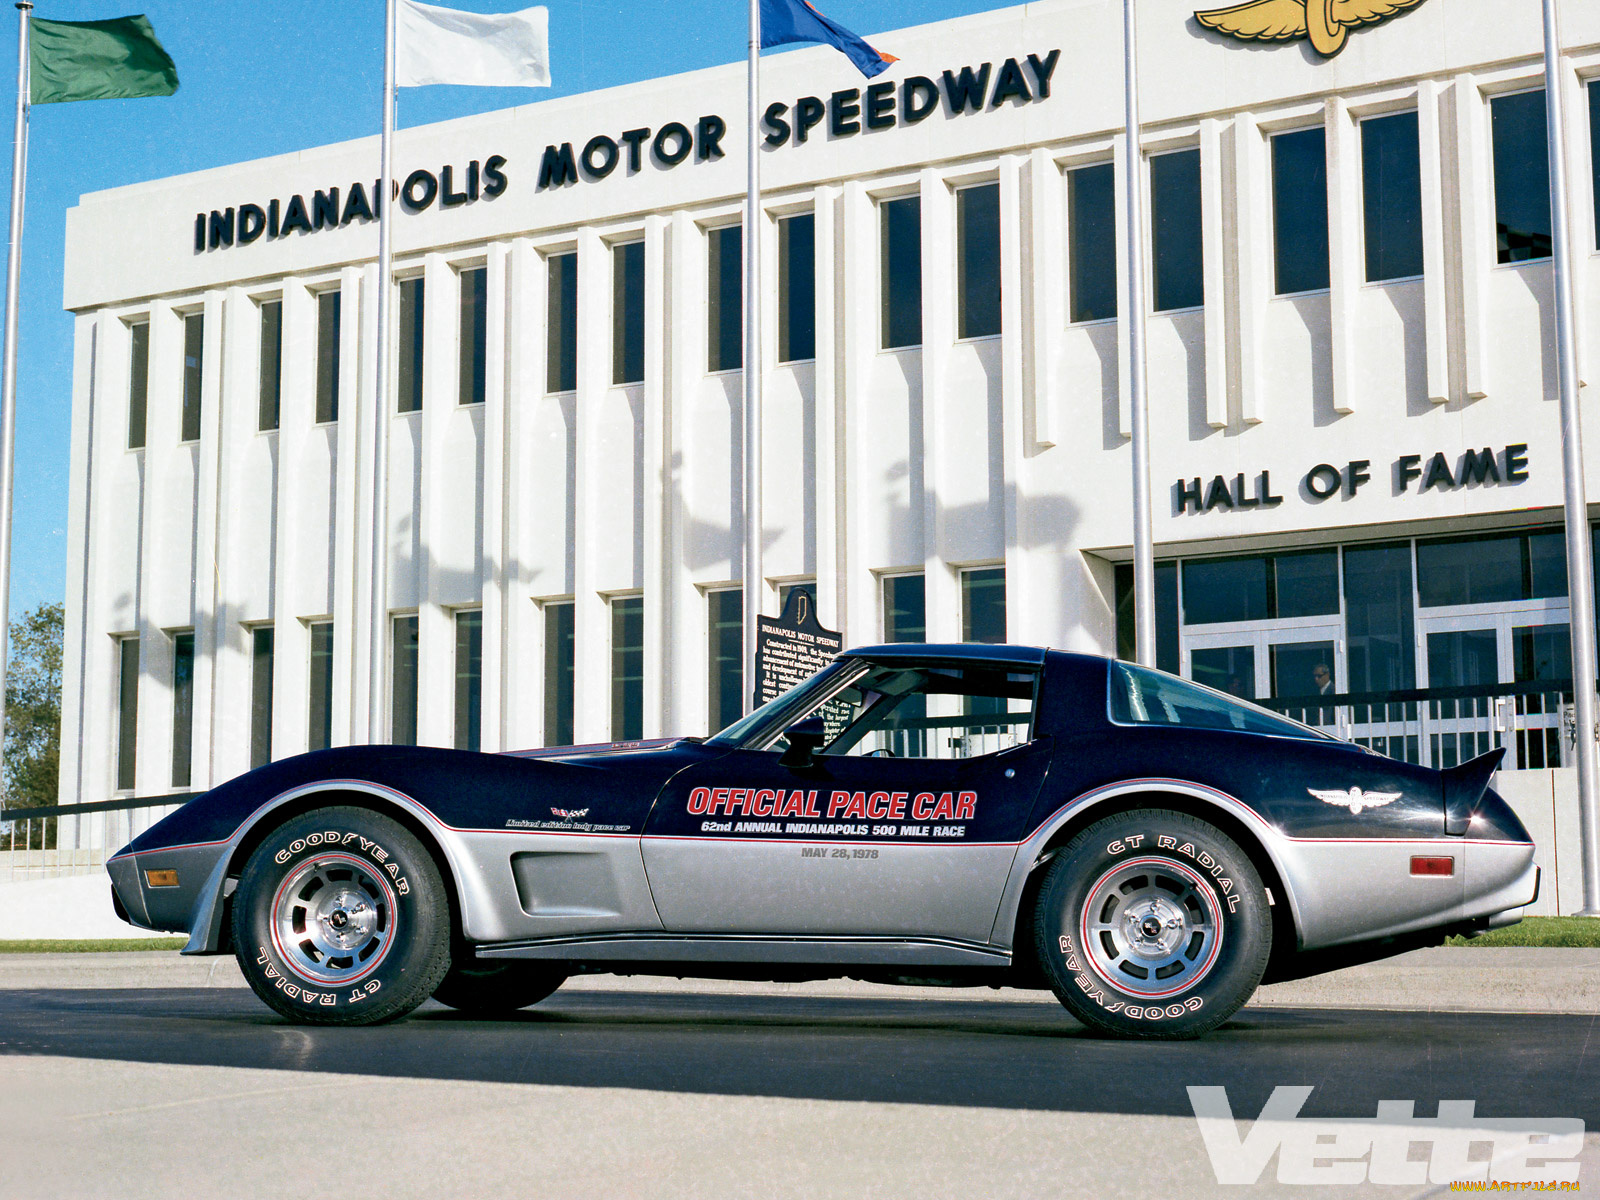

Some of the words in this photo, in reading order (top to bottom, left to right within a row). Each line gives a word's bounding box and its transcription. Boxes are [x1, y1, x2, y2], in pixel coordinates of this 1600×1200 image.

[538, 114, 726, 189] MOTOR
[765, 48, 1061, 147] SPEEDWAY
[1177, 470, 1284, 513] HALL
[1305, 459, 1371, 499] OF
[1399, 443, 1529, 492] FAME
[761, 624, 797, 639] INDIANAPOLIS
[797, 631, 815, 643] MOTOR
[816, 636, 840, 648] SPEEDWAY
[766, 638, 793, 650] Constructed
[810, 648, 818, 656] the
[771, 649, 797, 660] contributed
[762, 663, 771, 671] and
[798, 669, 804, 677] of
[686, 786, 821, 818] OFFICIAL
[826, 790, 909, 819] PACE
[911, 790, 978, 820] CAR
[505, 819, 541, 828] Limited
[701, 821, 733, 832] 62nd
[734, 822, 783, 833] ANNUAL
[785, 823, 869, 835] INDIANAPOLIS
[872, 825, 897, 836] 500
[900, 825, 930, 837] MILE
[932, 826, 965, 837] RACE
[275, 831, 410, 896] GOODYEAR
[801, 847, 828, 858] MAY
[1157, 834, 1241, 914] RADIAL
[256, 946, 337, 1006] RADIAL
